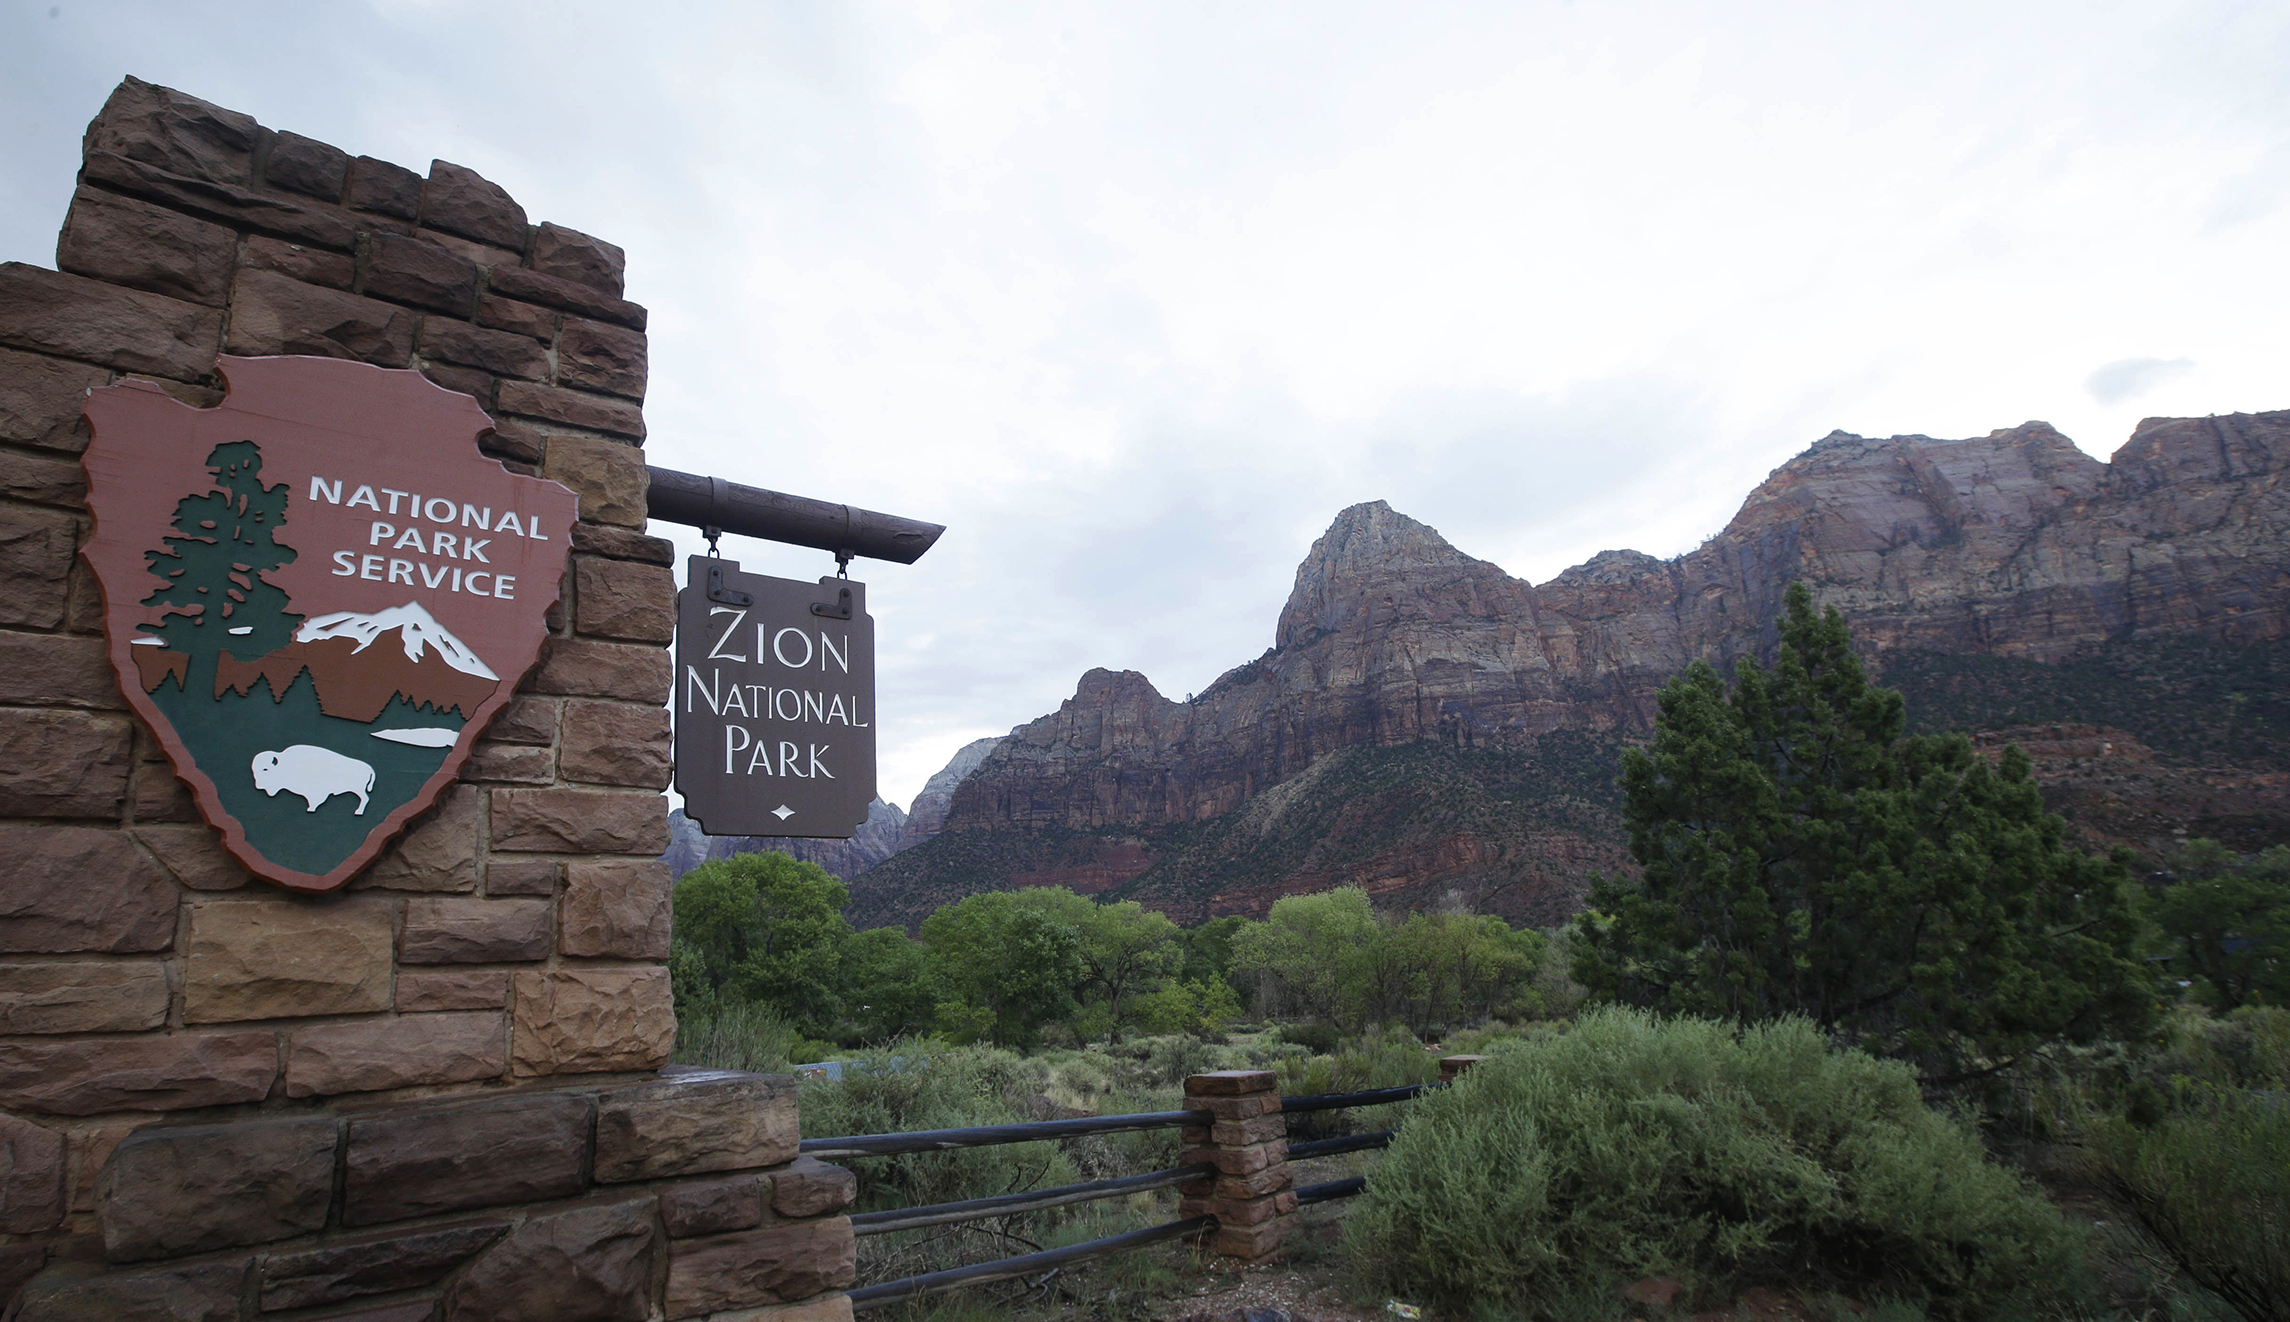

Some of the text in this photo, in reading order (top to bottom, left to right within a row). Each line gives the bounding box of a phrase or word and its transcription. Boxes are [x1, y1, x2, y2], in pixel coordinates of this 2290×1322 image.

[309, 475, 549, 541] NATIONAL
[369, 521, 492, 563] PARK
[331, 550, 516, 600] SERVICE
[708, 606, 848, 674] ZION
[686, 664, 869, 728] NATIONAL
[725, 724, 836, 779] PARK
